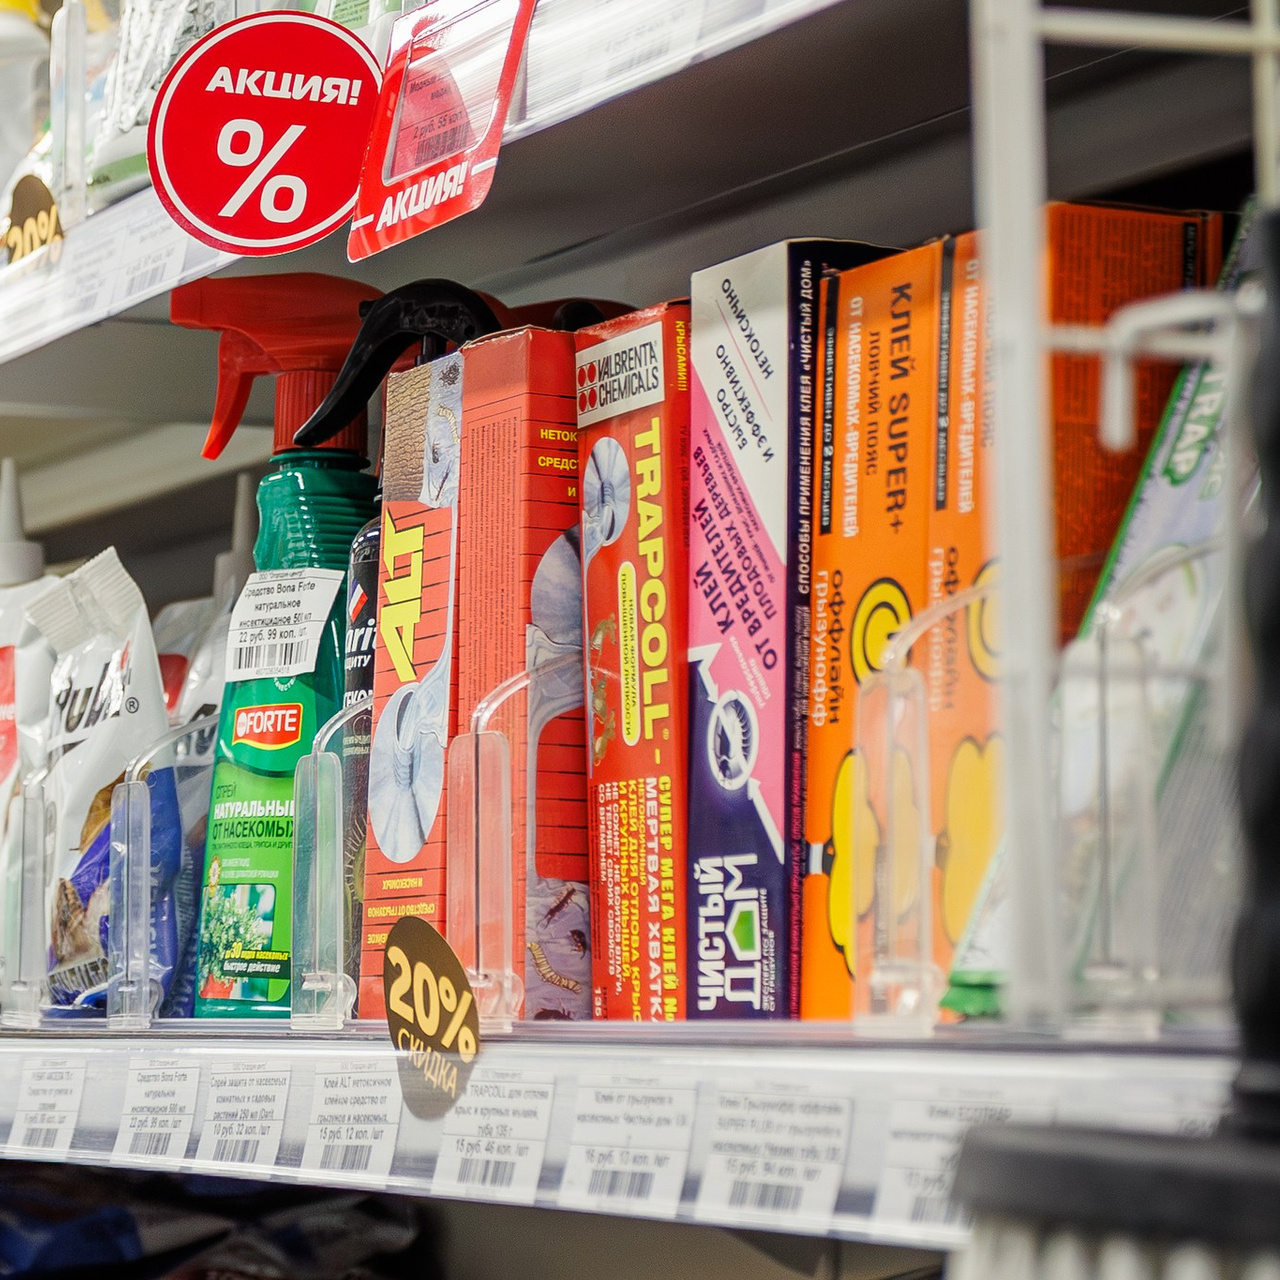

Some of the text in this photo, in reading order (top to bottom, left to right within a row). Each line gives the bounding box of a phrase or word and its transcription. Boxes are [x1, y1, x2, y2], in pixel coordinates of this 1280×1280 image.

[205, 65, 362, 107] АКЦИЯ!
[216, 118, 308, 224] %
[375, 162, 467, 232] АКЦИЯ!
[595, 340, 658, 384] VALBRENTA
[675, 320, 687, 392] КРЫСАМИ!!!
[720, 277, 774, 380] НЕТОКСИЧНО
[597, 366, 660, 409] CHEMICALS
[715, 343, 775, 463] И ЭФФЕКТИВНО
[715, 387, 748, 450] БЫСТРО
[798, 260, 813, 595] СПОСОБЫ ПРИМЕНЕНИЯ КЛЕЯ «ЧИСТЫЙ ДОМ»
[821, 326, 836, 527] ЭФФЕКТИВЕН ДО МЕСЯЦЕВ
[841, 296, 864, 539] ОТ НАСЕКОМЫХ-ВРЕДИТЕЛЕЙ
[865, 330, 882, 477] ЛОВЧИЙ ПОЯС
[885, 281, 916, 535] КЛЕЙ SUPER+
[692, 444, 778, 621] ПЛОДОВЫХ ДЕРЕВЬЕВ
[254, 599, 301, 613] натуральное
[276, 582, 296, 594] Bona
[380, 506, 425, 683] ALT
[634, 416, 670, 740] TRAPCOLL
[692, 497, 779, 671] ОТ ВРЕДИТЕЛЕЙ
[692, 559, 736, 635] КЛЕЙ
[239, 629, 296, 645] 22 руб. 99 коп.
[621, 573, 632, 736] ПОВЫШЕННОЙ ЛИПКОСТИ
[629, 645, 637, 708] ФОРМУЛА
[811, 569, 829, 727] грызунофф
[828, 569, 846, 724] оффлайн
[245, 708, 299, 733] FORTE
[212, 822, 223, 840] ОТ
[605, 804, 613, 855] ТЕРЯЕТ
[611, 803, 620, 861] СОХНЕТ,
[619, 799, 629, 894] КРУПНЫХ
[637, 778, 647, 885] НЕТОКСИЧНЫЙ
[646, 777, 660, 913] МЕРТВАЯ
[382, 878, 418, 891] НАСЕКОМЫХ
[627, 779, 641, 1022] КЛЕЙ ДЛЯ ОТЛОВА КРЫС
[658, 775, 679, 990] СУПЕР МЕГА КЛЕЙ
[608, 909, 616, 975] СВОЙСТВ
[614, 945, 622, 996] ВЛАГИ,
[621, 899, 632, 983] МЫШЕЙ.
[693, 855, 725, 1011] ЧИСТЫЙ
[723, 852, 761, 1010] ДОМ
[759, 887, 770, 1011] ЭКСПЕРТ ПО ЗАЩИТЕ
[768, 930, 776, 993] ГРЫЗУНОВ
[386, 945, 478, 1064] 20%
[323, 1076, 339, 1088] Клей
[339, 1076, 351, 1088] ALT
[323, 1094, 379, 1107] клейкое средство
[396, 1025, 458, 1098] СКИДКА
[138, 1117, 150, 1131] руб.
[213, 1123, 222, 1135] 10
[222, 1123, 234, 1138] руб.
[235, 1123, 244, 1135] 32
[244, 1125, 258, 1135] коп.
[319, 1127, 384, 1143] 15 руб. 12 коп. /шт
